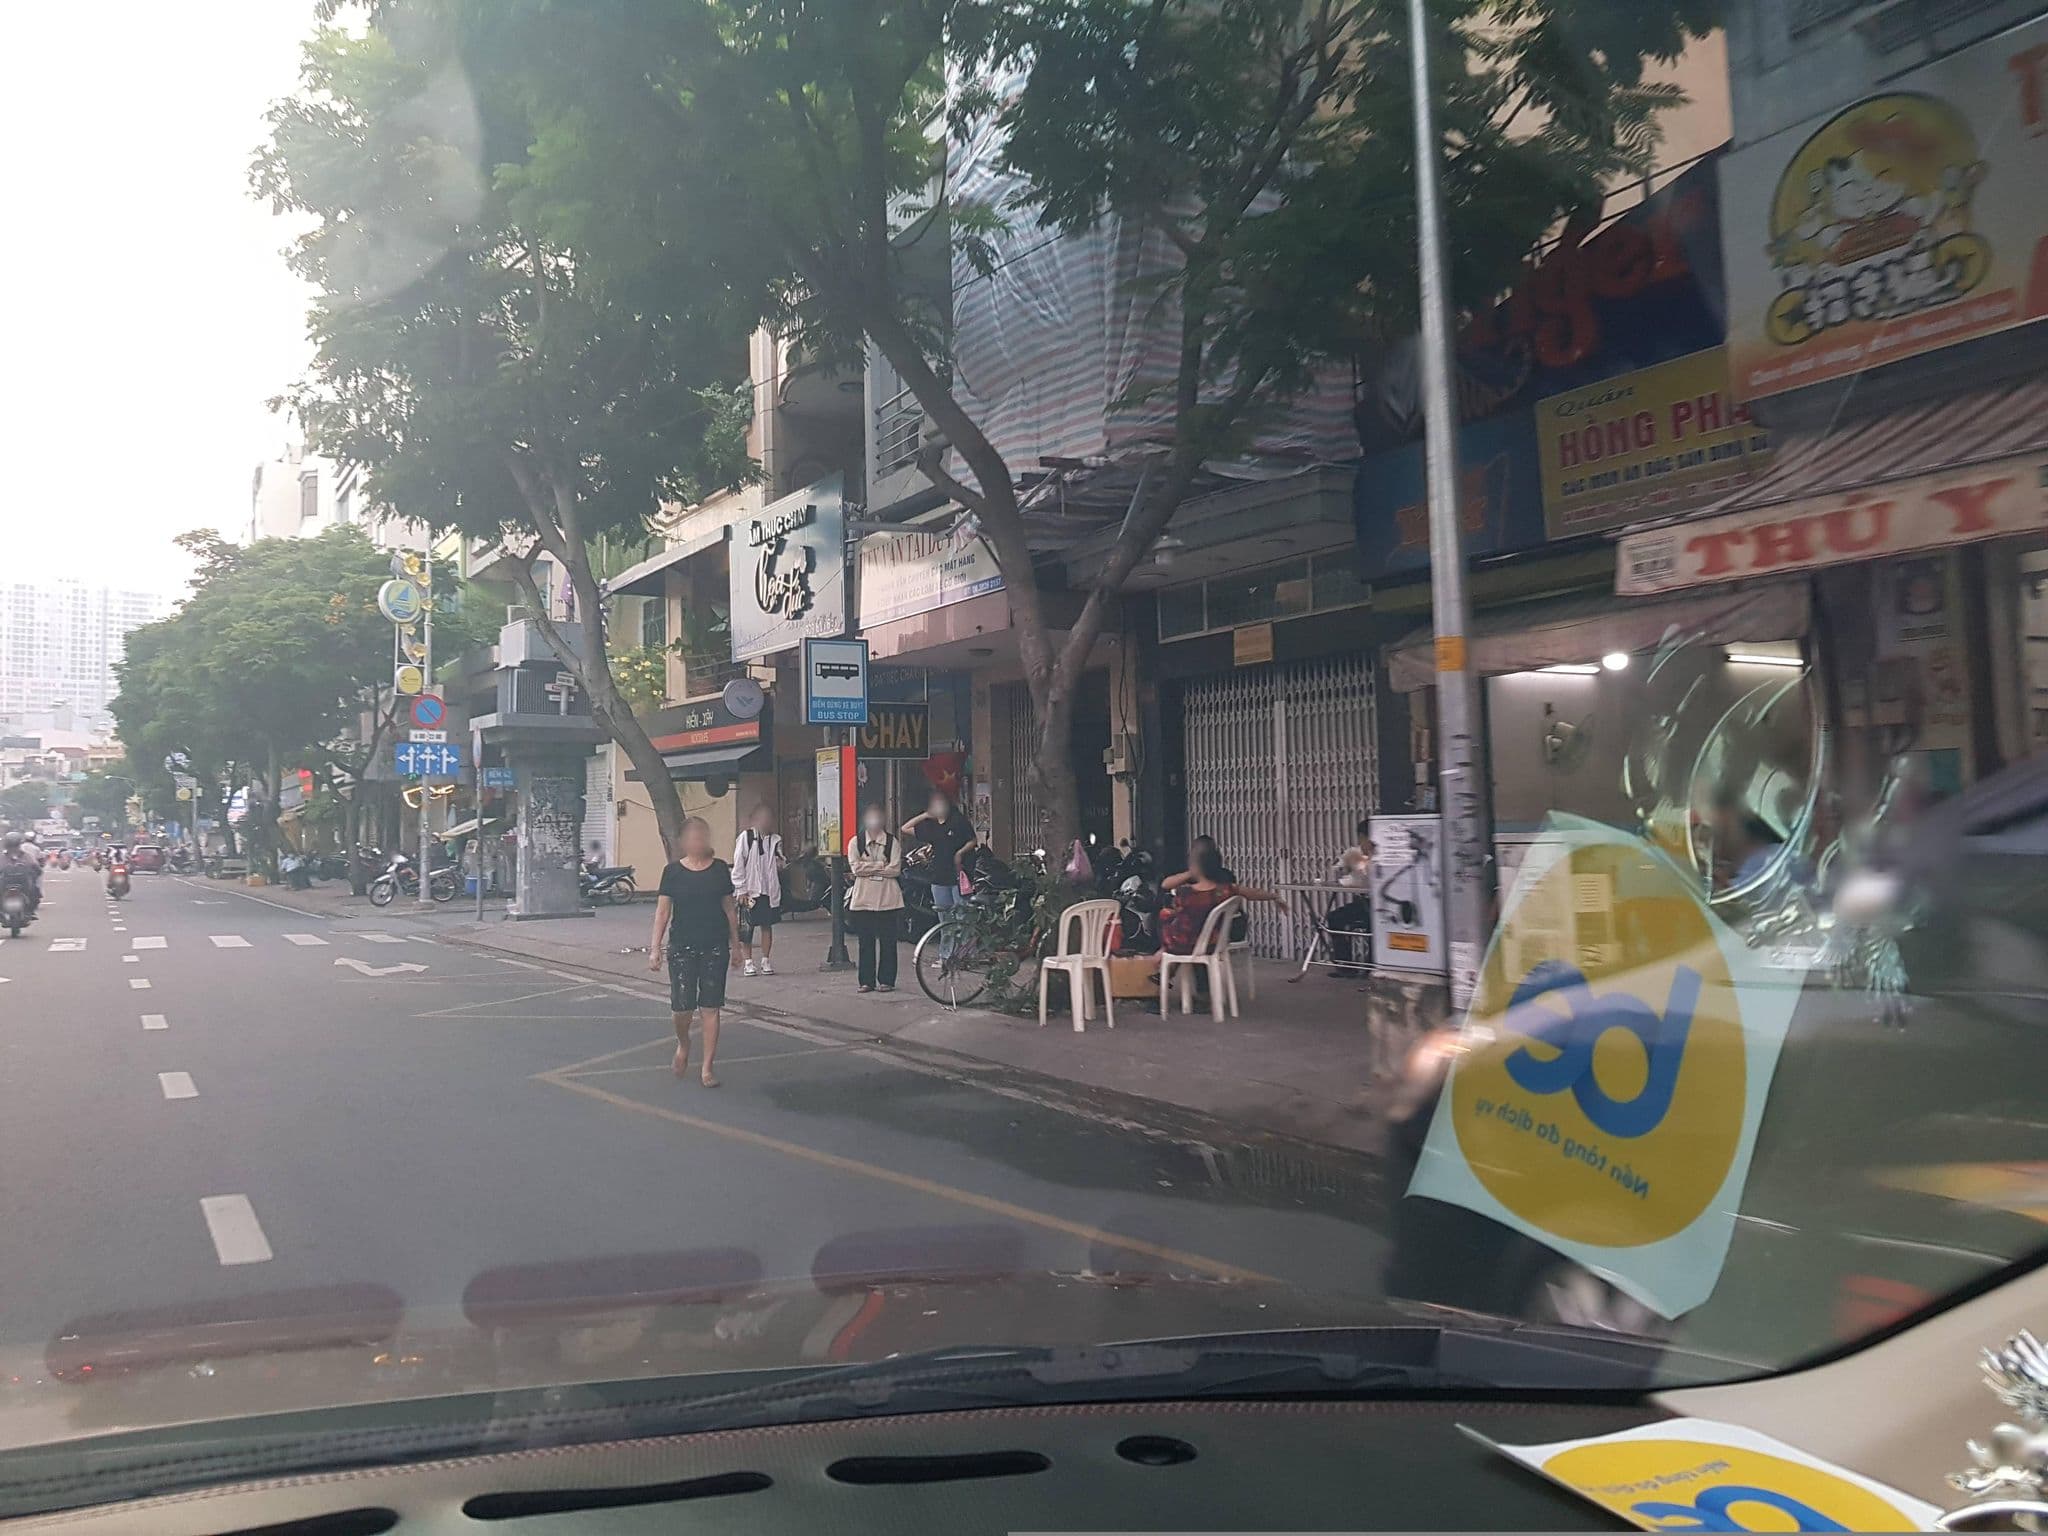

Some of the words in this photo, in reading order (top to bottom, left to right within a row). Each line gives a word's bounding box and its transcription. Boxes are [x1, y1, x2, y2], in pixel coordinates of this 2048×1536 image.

[817, 711, 835, 720] BUS
[838, 711, 860, 720] STOP
[861, 712, 924, 749] CHAY
